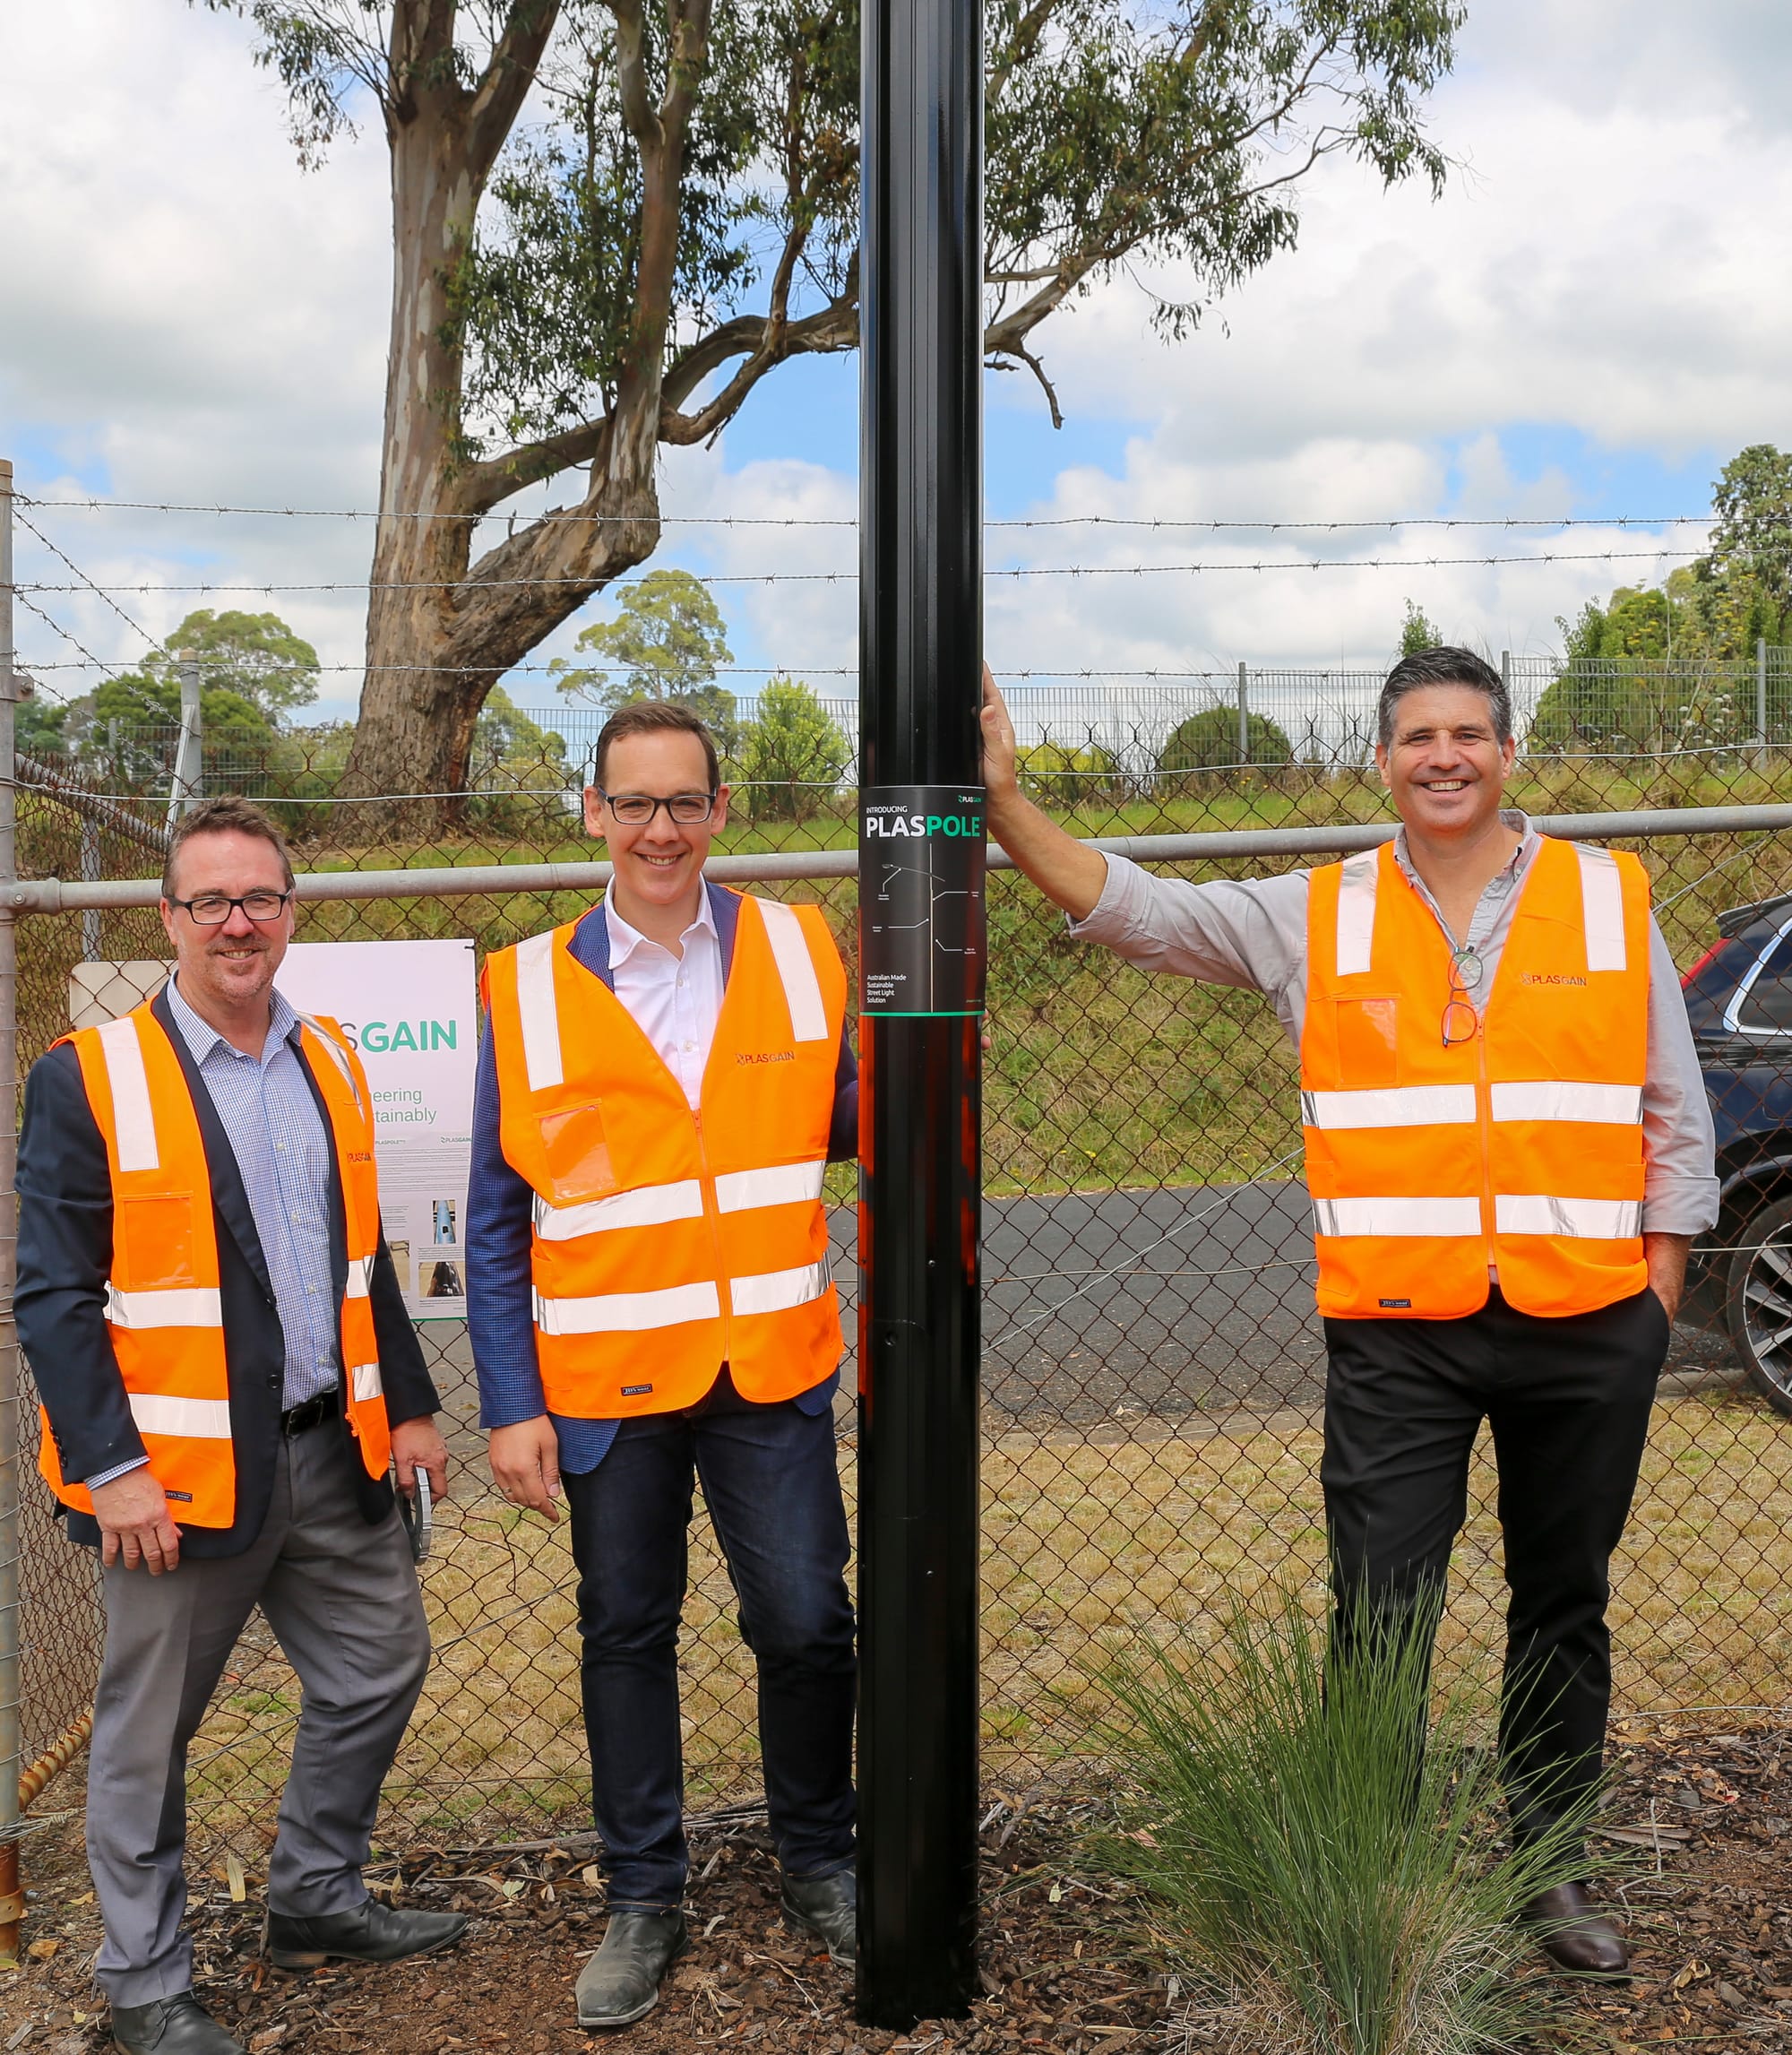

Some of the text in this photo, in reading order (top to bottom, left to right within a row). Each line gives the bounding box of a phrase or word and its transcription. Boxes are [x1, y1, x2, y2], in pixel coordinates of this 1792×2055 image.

[866, 806, 908, 814] INTRODUCING
[866, 816, 980, 838] PLASPOLE
[1531, 974, 1587, 986] PLASGAIN
[745, 1050, 795, 1064] PLASGAIN
